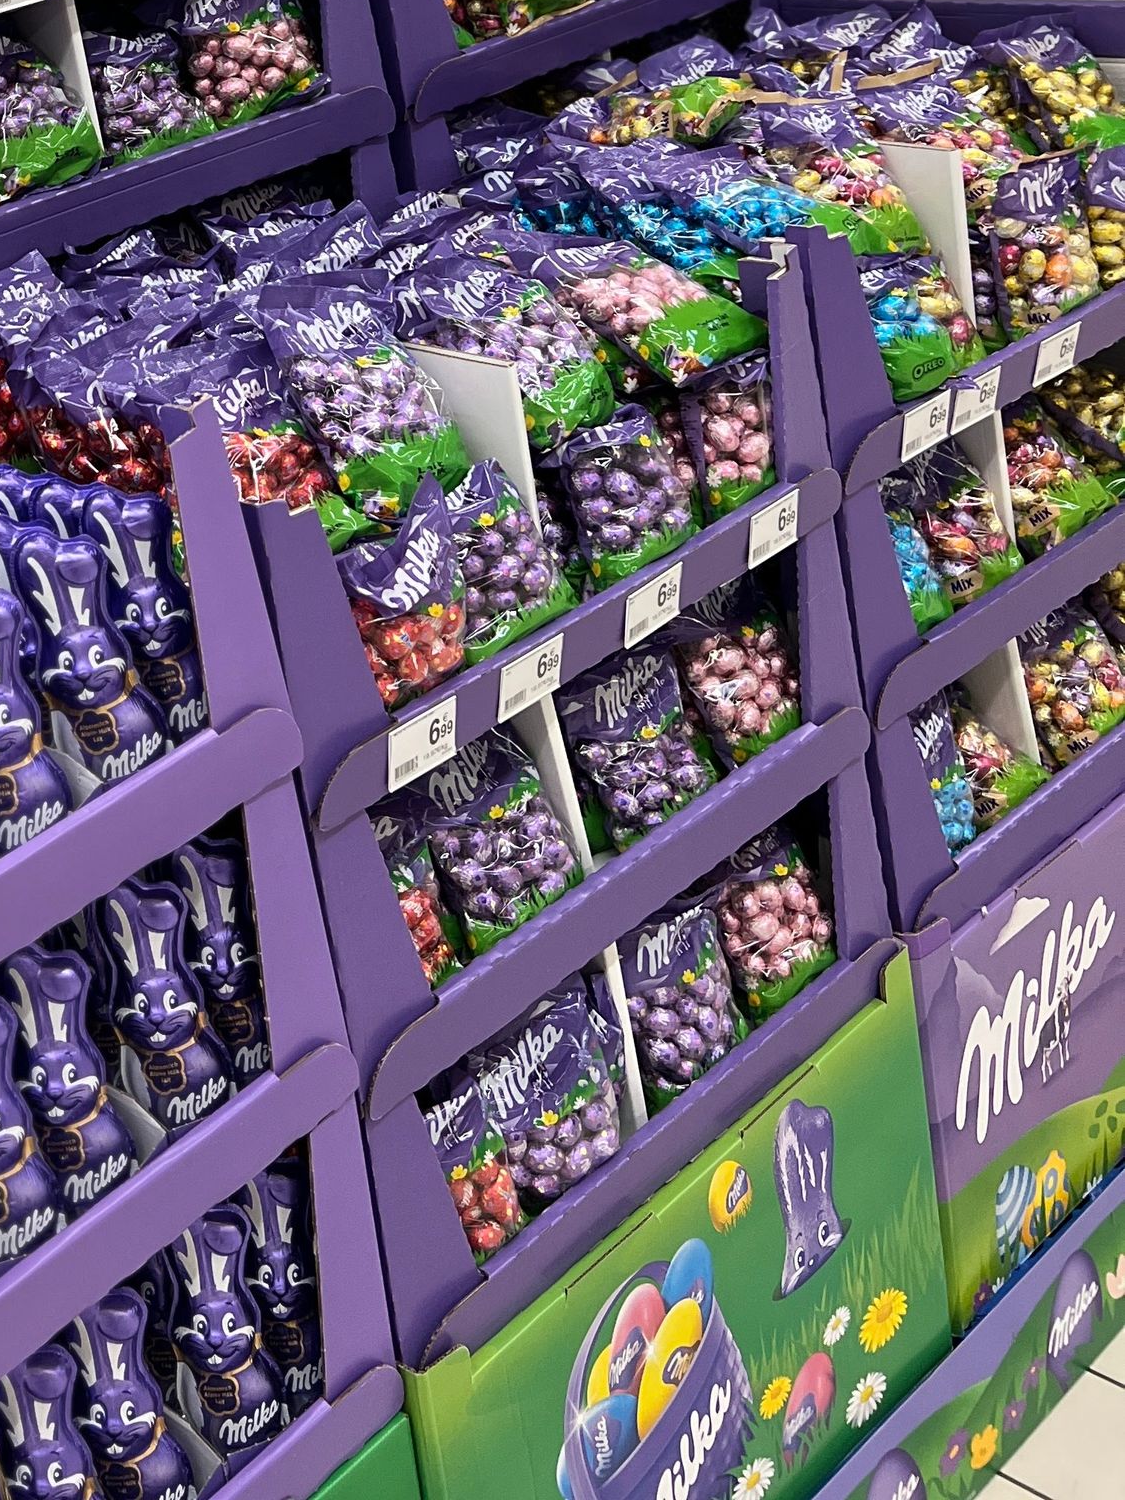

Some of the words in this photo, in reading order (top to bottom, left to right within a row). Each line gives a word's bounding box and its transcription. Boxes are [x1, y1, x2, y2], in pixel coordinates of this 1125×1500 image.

[870, 21, 922, 62] Milka
[965, 184, 988, 203] Mix
[1020, 161, 1064, 214] Milka
[306, 237, 364, 273] Milka
[445, 269, 501, 316] Milka
[297, 300, 371, 352] Milka
[1028, 311, 1052, 325] Mix
[913, 356, 946, 379] OREO
[1029, 505, 1052, 528] Mix
[382, 528, 440, 611] Milka
[951, 576, 973, 594] Mix
[595, 654, 664, 728] Milka
[170, 697, 207, 732] Mil
[102, 732, 162, 778] Milka
[1067, 735, 1093, 754] Mix
[429, 738, 488, 815] Milka
[975, 797, 1000, 817] Mix
[956, 896, 1115, 1144] Milka
[482, 1022, 564, 1118] Milka
[167, 1076, 227, 1124] Milka
[64, 1153, 128, 1201] Milka
[728, 1169, 746, 1208] Milka
[1048, 1280, 1099, 1358] Milka
[285, 1364, 323, 1394] Mil
[610, 1340, 641, 1384] Milka
[219, 1399, 279, 1446] Milka
[595, 1416, 614, 1478] Milka
